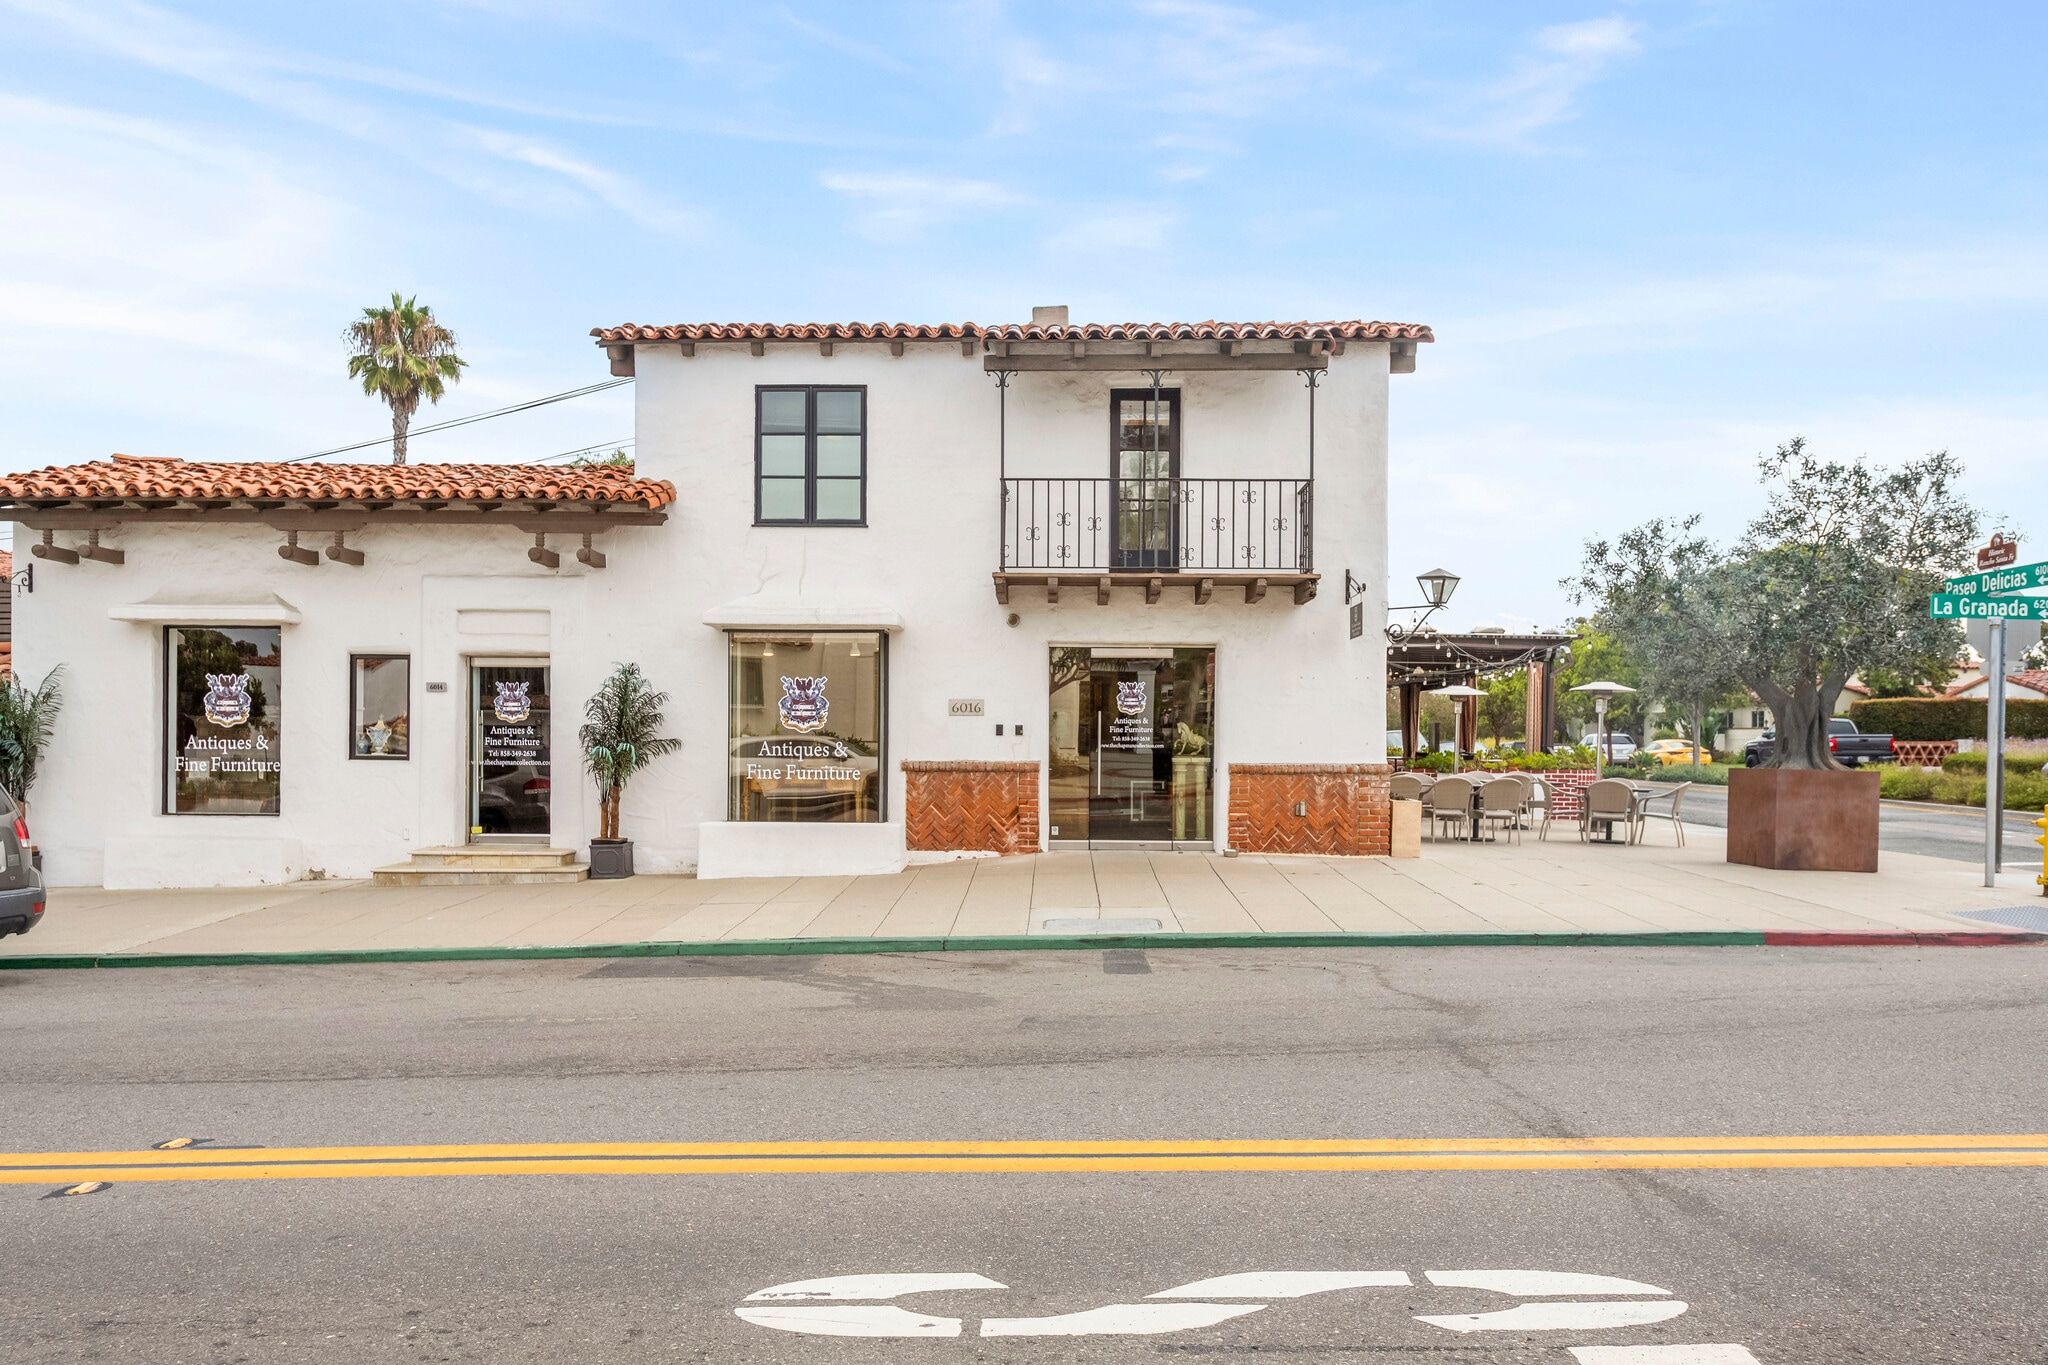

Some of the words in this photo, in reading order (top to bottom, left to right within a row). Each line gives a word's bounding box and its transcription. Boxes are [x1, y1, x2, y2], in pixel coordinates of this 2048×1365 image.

[1945, 581, 1977, 595] Paseo
[1982, 570, 2028, 592] Delicias
[1933, 597, 1953, 615] La
[1959, 598, 2028, 616] Granada
[951, 702, 982, 713] 6016
[1114, 717, 1141, 726] Antiques
[490, 726, 525, 737] Antiques
[526, 726, 534, 735] &
[185, 735, 252, 754] Antiques
[256, 735, 269, 750] &
[484, 737, 502, 746] Fine
[503, 737, 540, 746] Furniture
[758, 741, 830, 761] Antiques
[834, 741, 849, 758] &
[175, 757, 207, 772] Fine
[210, 757, 281, 772] Furniture
[746, 764, 781, 780] Fine
[785, 764, 861, 780] Furniture
